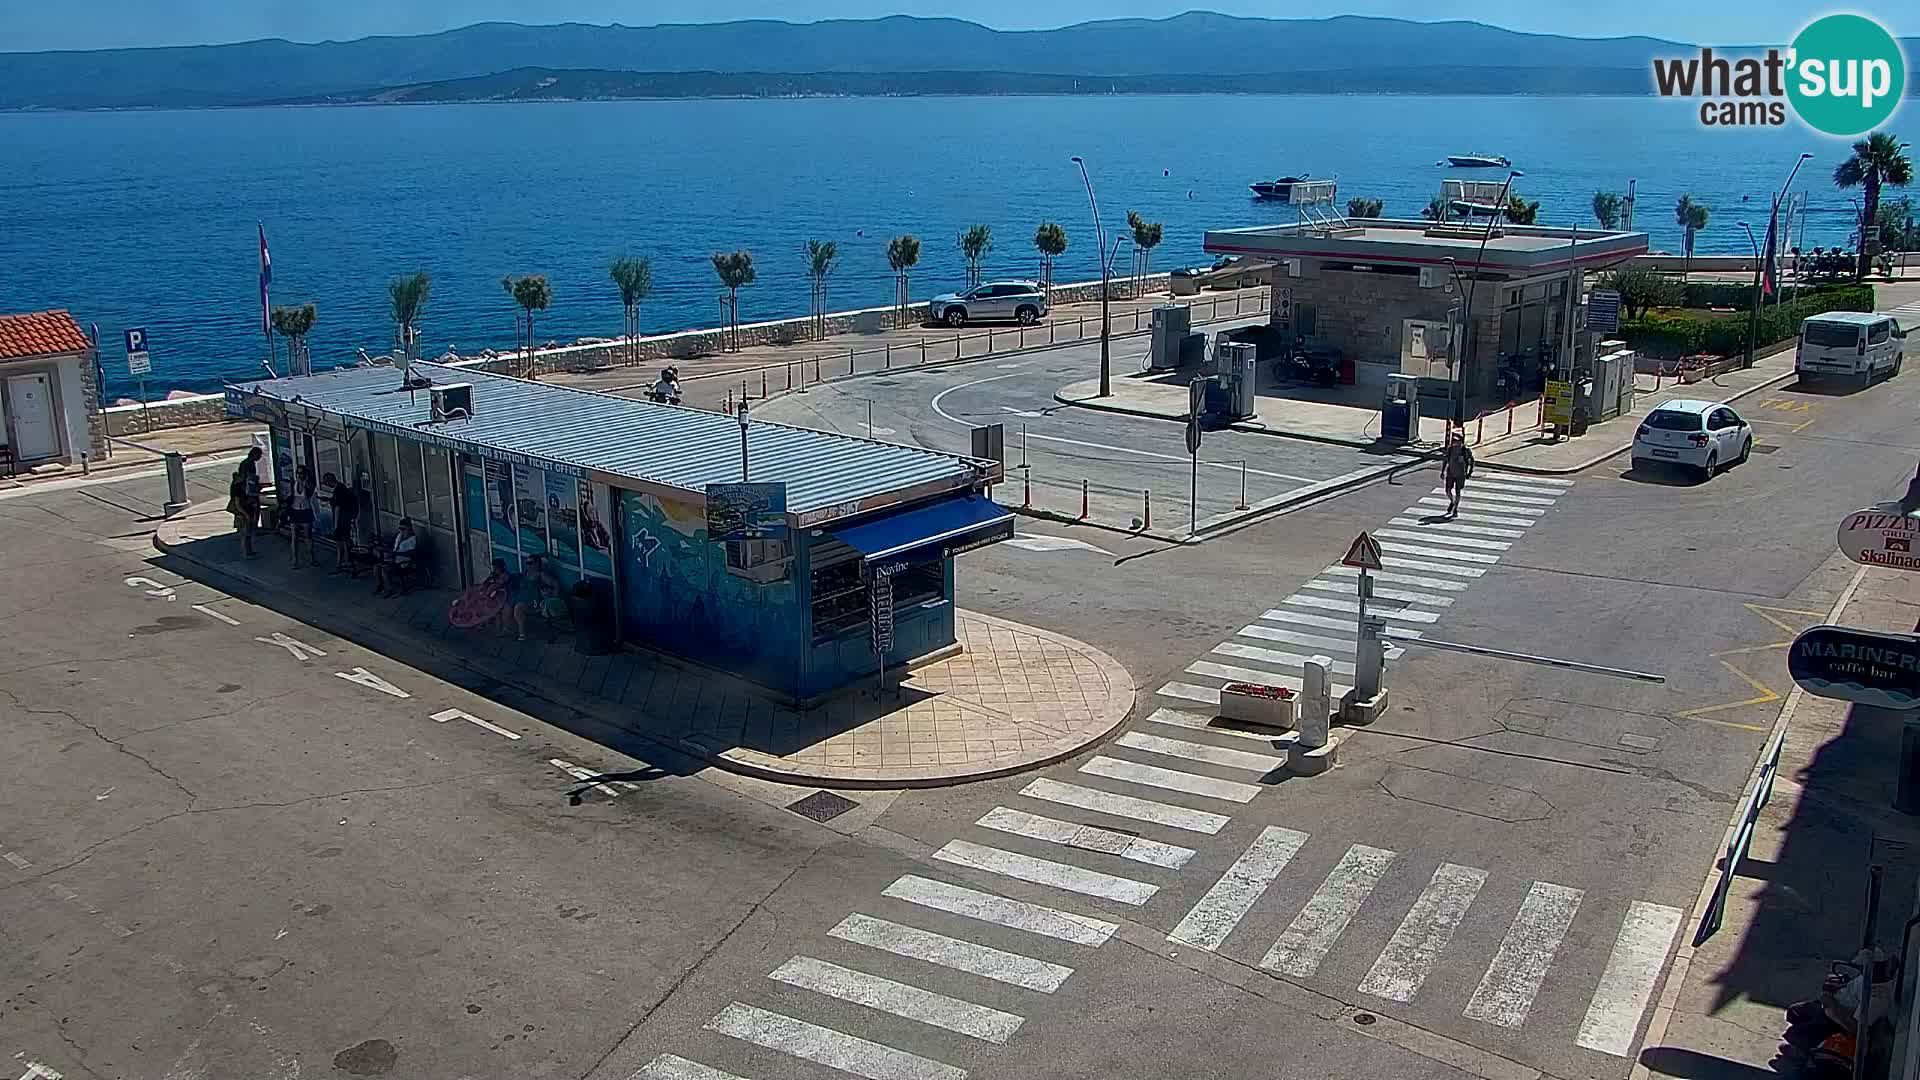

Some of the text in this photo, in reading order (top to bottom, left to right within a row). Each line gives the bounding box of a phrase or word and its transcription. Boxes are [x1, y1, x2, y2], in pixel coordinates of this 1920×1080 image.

[129, 331, 142, 350] P
[436, 436, 467, 452] POSTAJA
[477, 446, 492, 457] BUS
[493, 451, 526, 465] STATION
[527, 458, 554, 471] TICKET
[555, 463, 582, 477] OFFICE
[1847, 514, 1920, 532] PIZZE
[1800, 641, 1920, 672] MARINER
[1828, 662, 1897, 680] caffe bar
